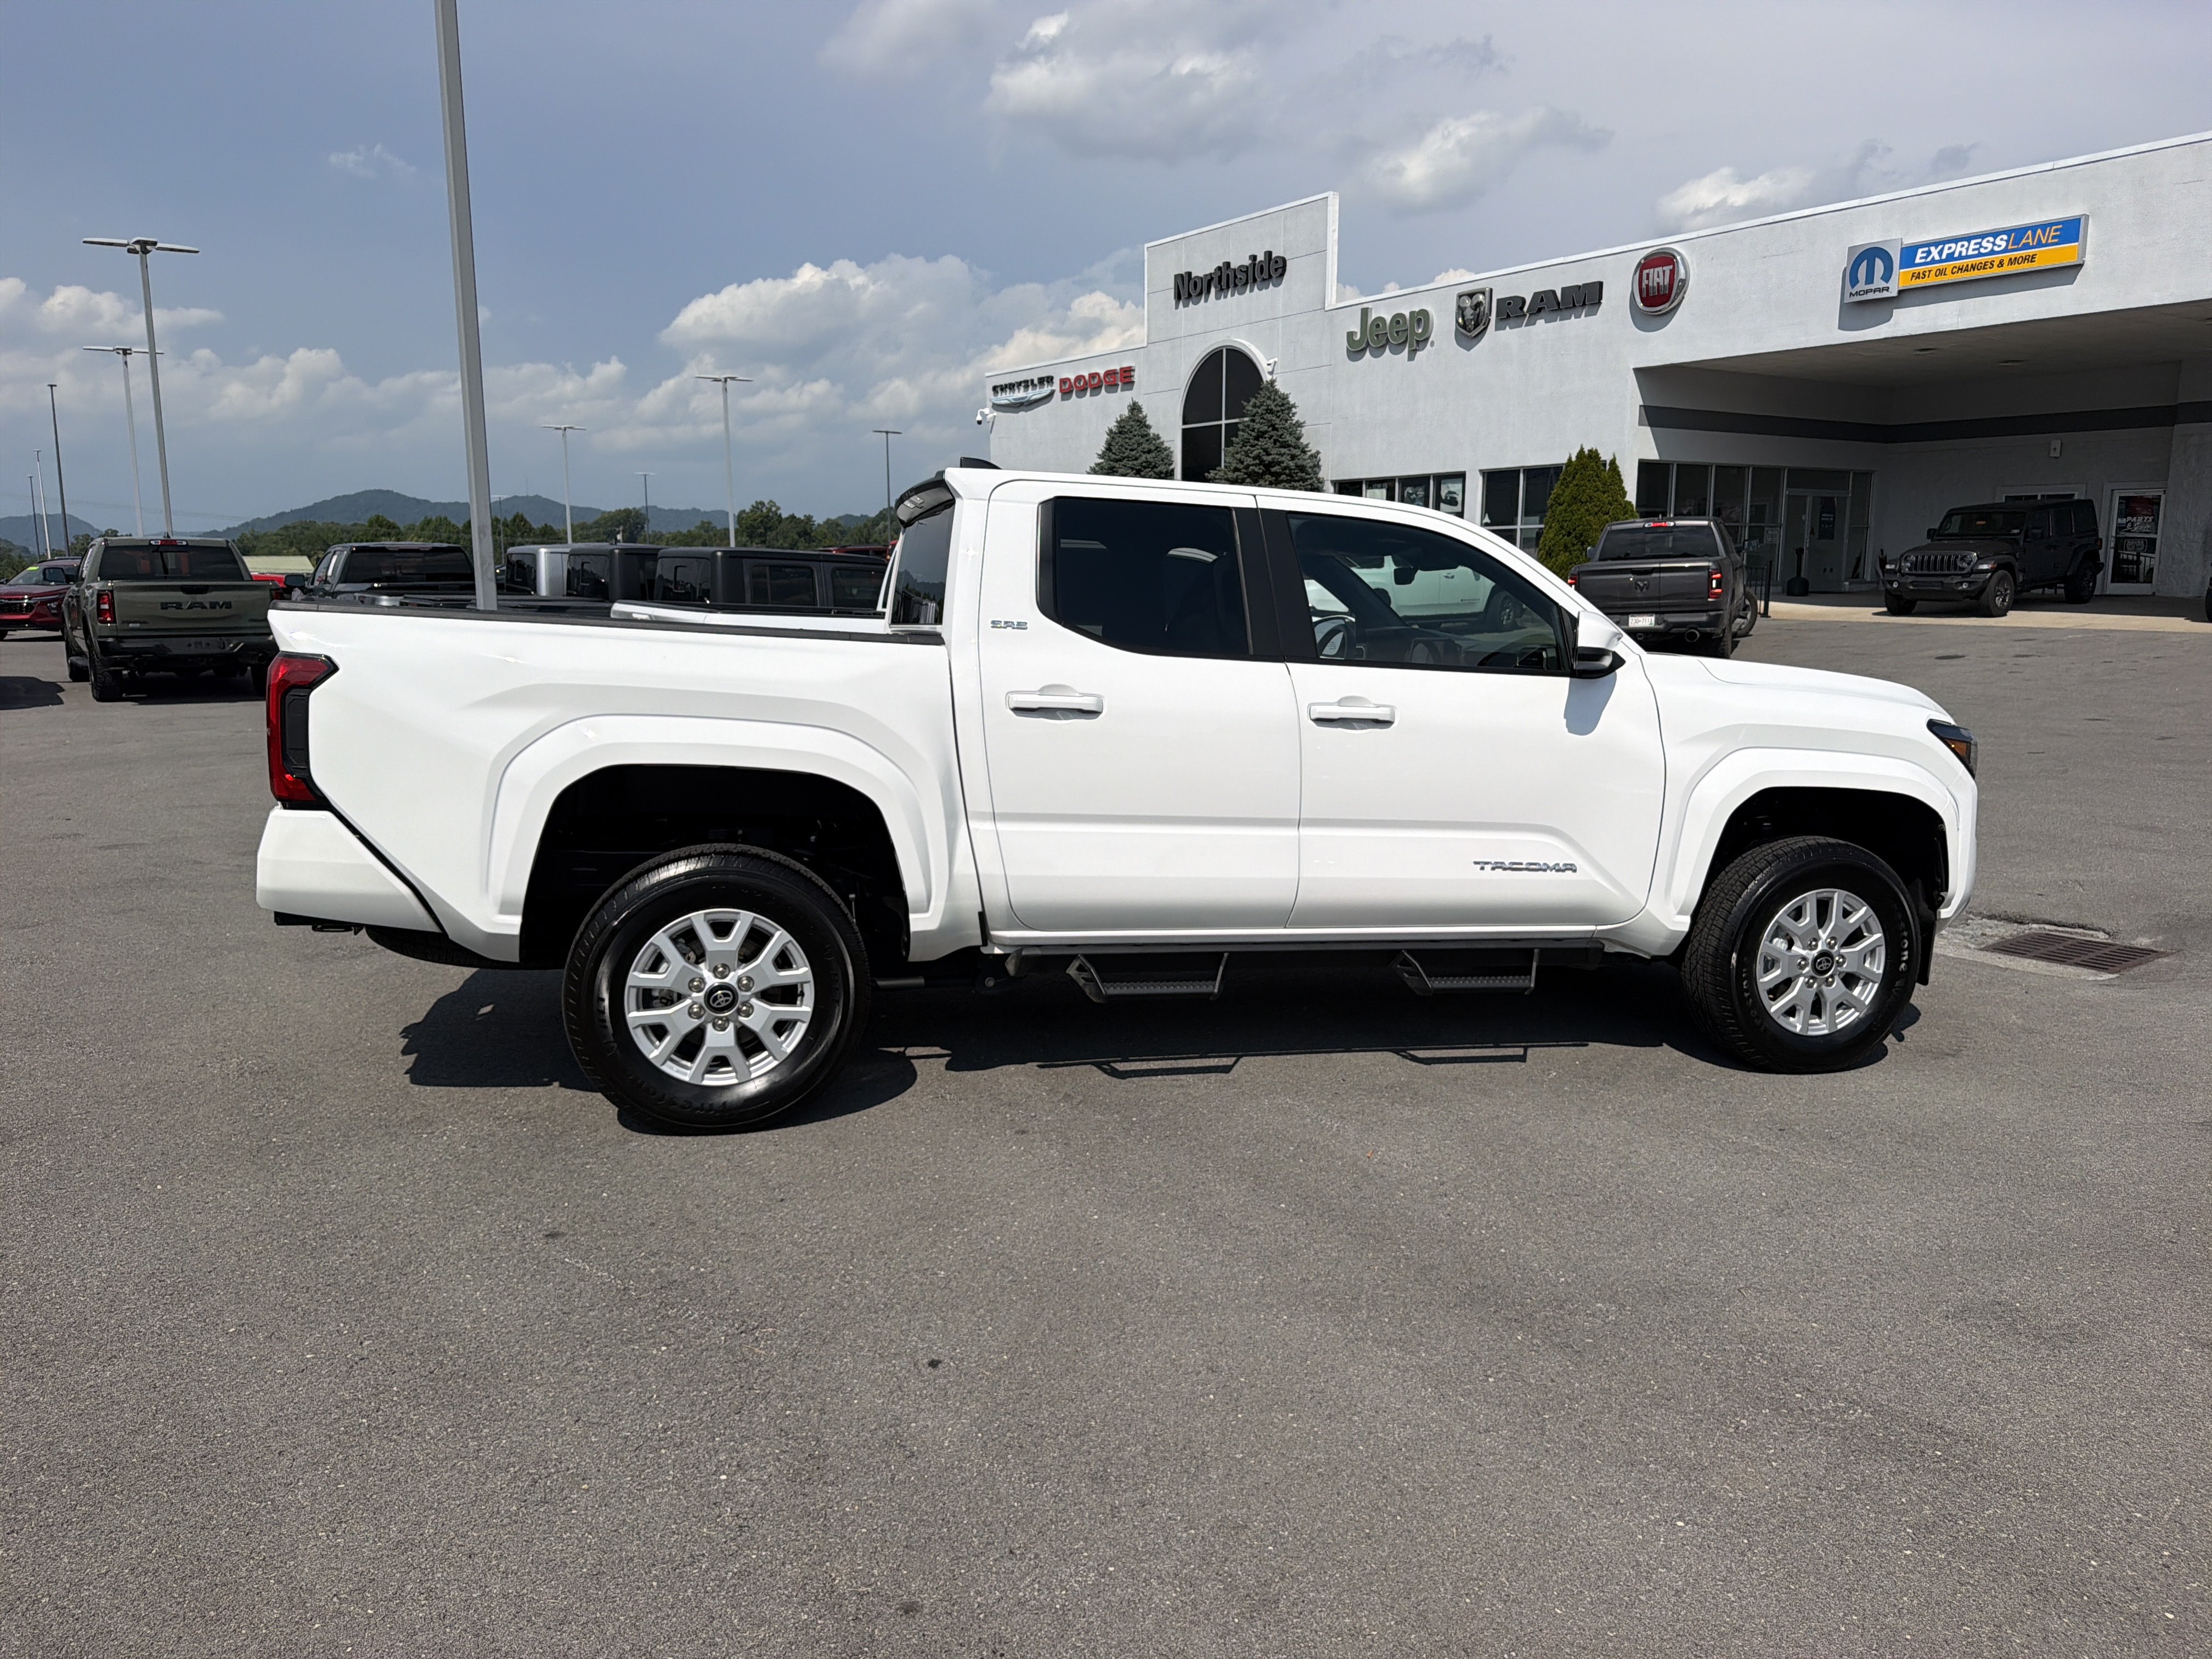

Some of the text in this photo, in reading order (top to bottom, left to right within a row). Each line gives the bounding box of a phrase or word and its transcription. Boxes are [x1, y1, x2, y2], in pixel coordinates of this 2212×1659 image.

[1173, 250, 1286, 301] Northside
[1910, 253, 2038, 281] FAST OIL CHANGES & MORE
[1642, 265, 1673, 297] FIAT
[1849, 286, 1889, 298] MOPAR
[1496, 281, 1604, 319] RAM
[1346, 307, 1434, 350] Jeep
[992, 375, 1054, 393] CHRYSLER
[1059, 366, 1134, 393] DODGE
[160, 601, 232, 610] RAM
[1473, 861, 1577, 873] TACOMA
